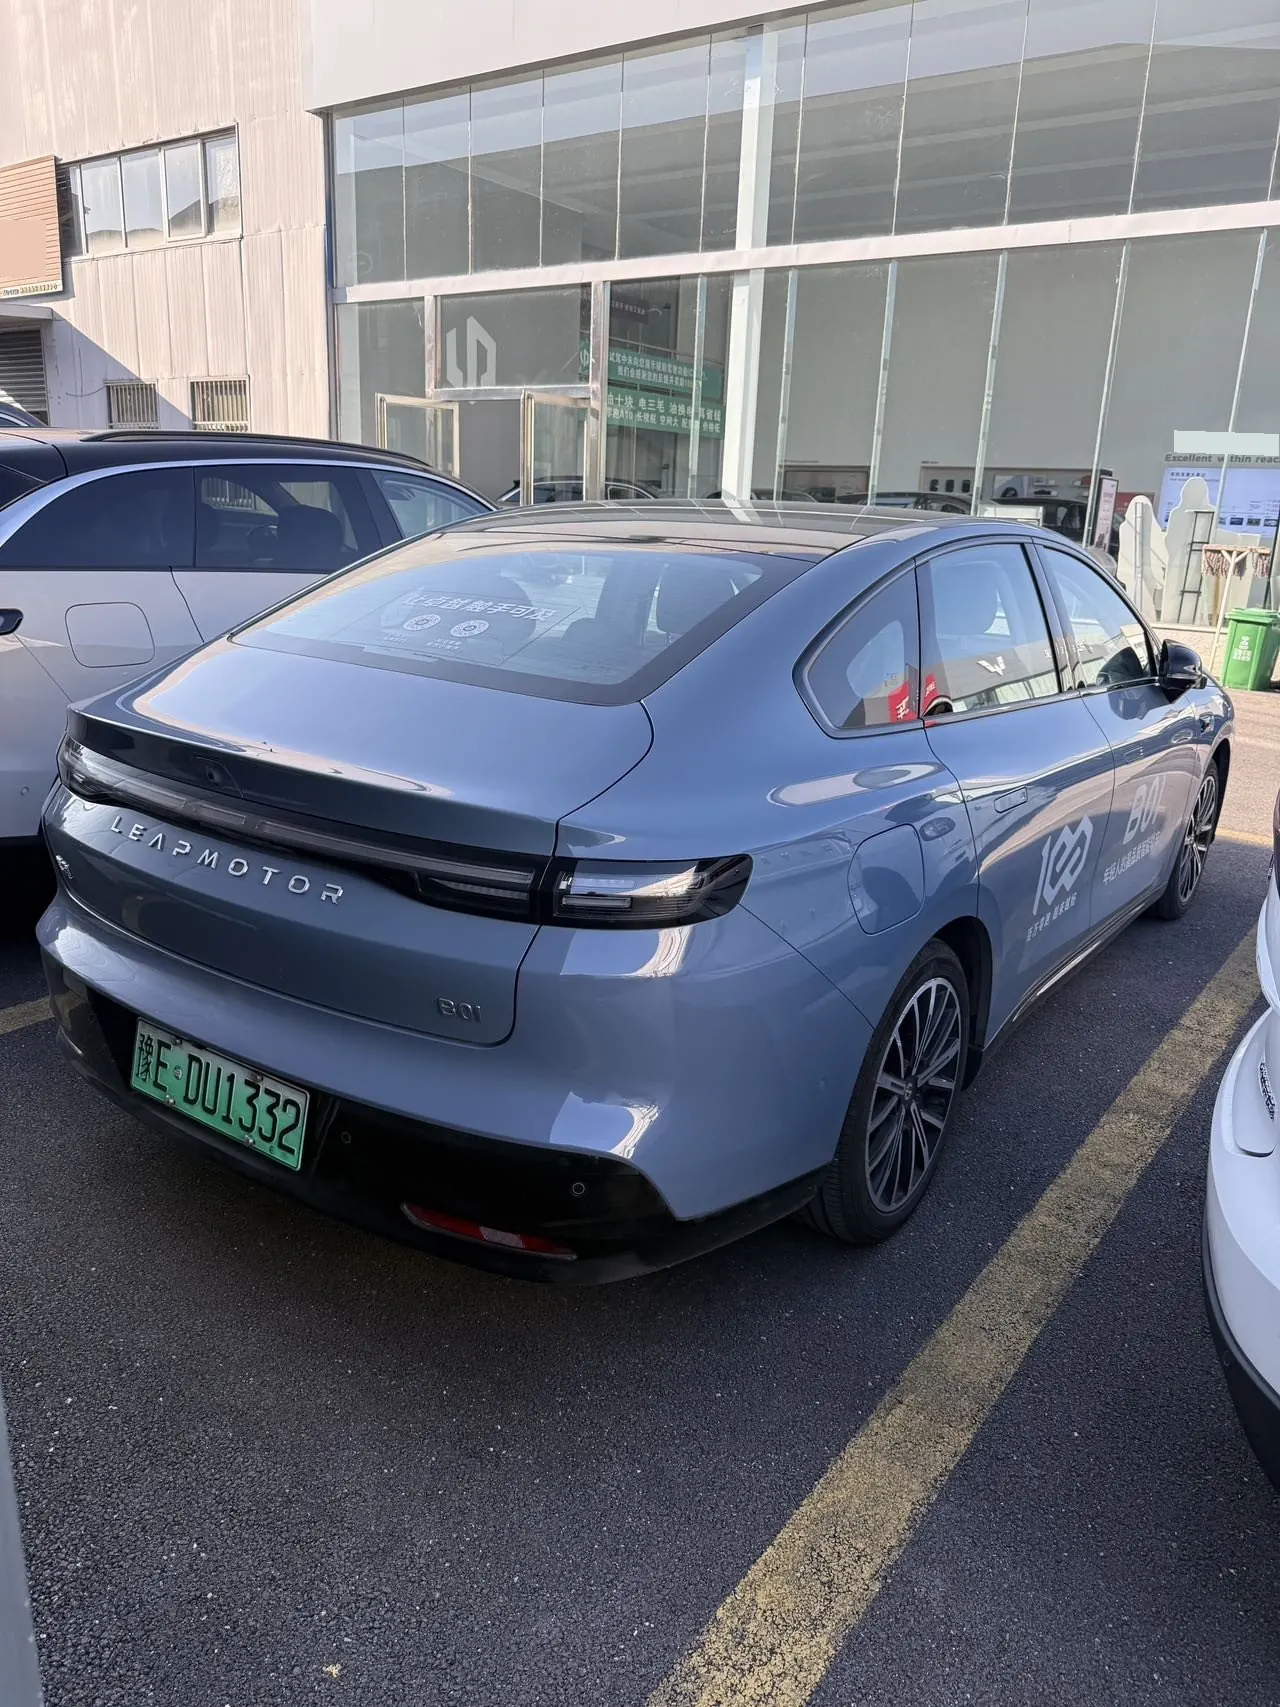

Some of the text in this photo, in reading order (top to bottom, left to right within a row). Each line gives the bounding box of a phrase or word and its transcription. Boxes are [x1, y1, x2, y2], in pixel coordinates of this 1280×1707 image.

[639, 397, 665, 413] 电三毛
[1164, 454, 1213, 463] Excellent
[1217, 454, 1252, 464] wthin
[1122, 773, 1167, 845] B01
[110, 815, 344, 904] LEAPMOTOR
[437, 996, 483, 1023] B01
